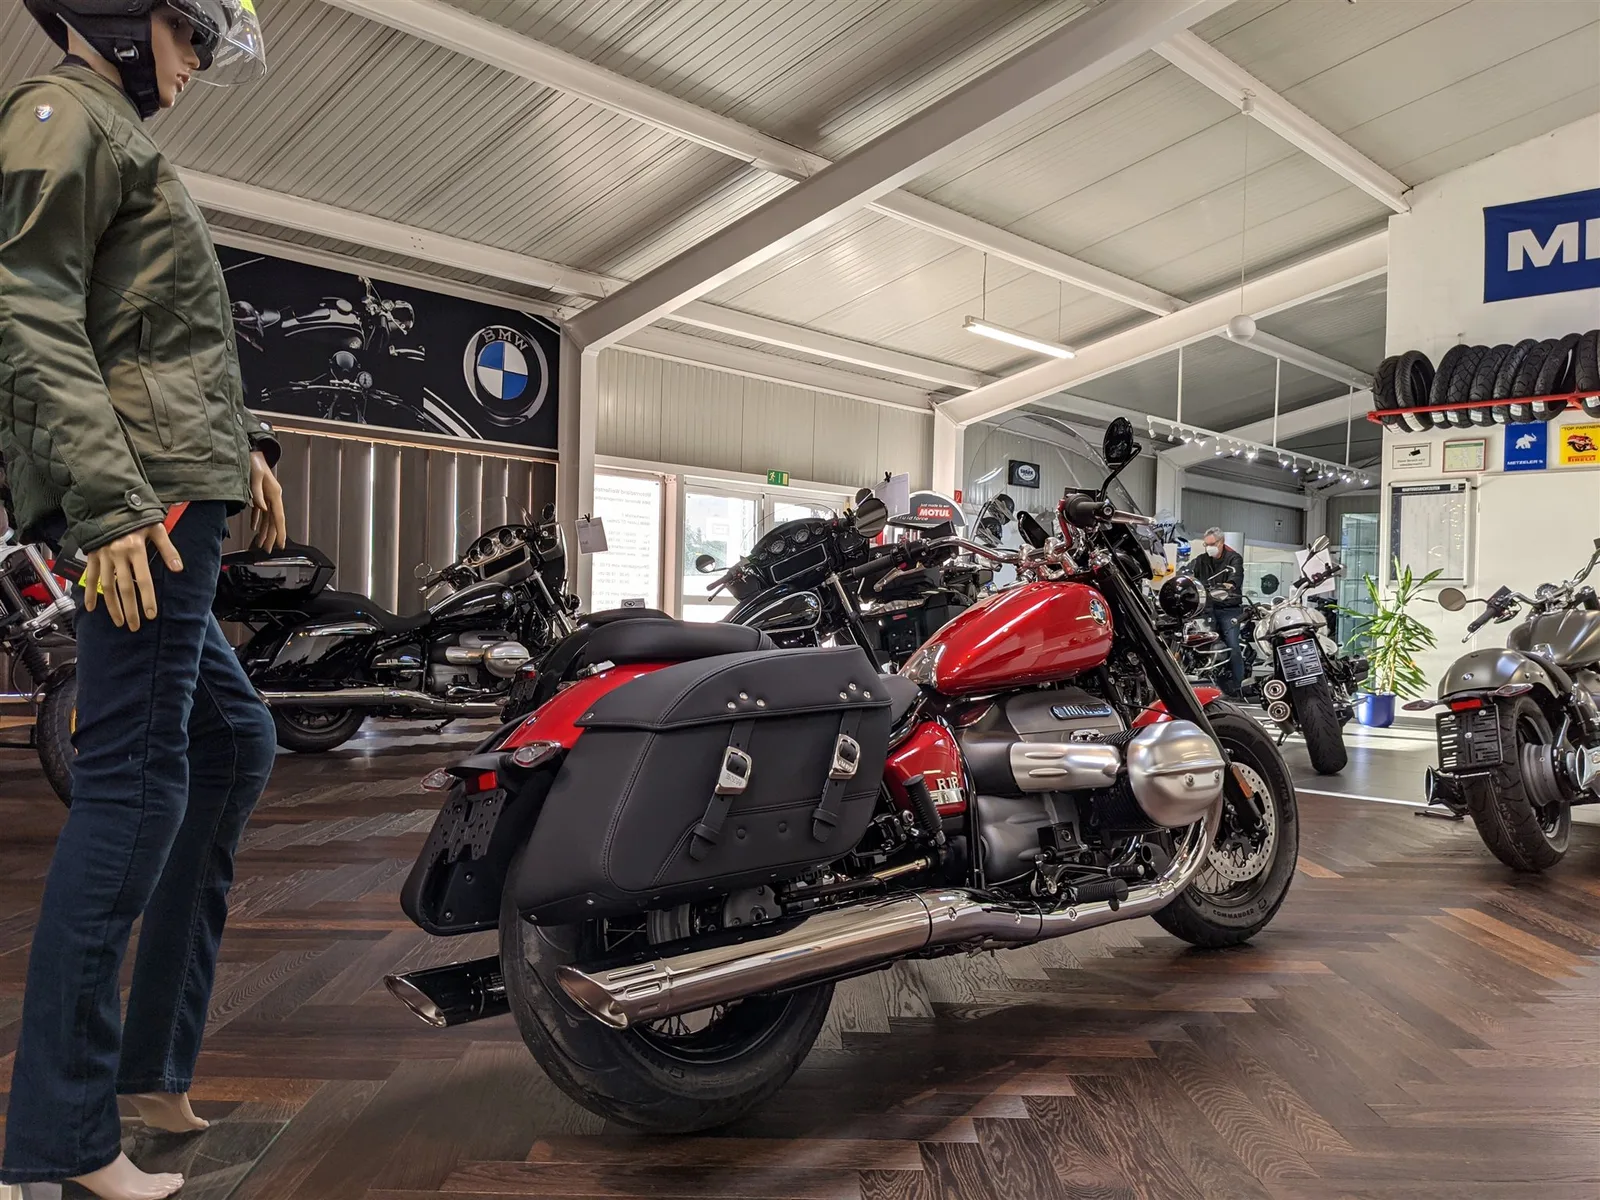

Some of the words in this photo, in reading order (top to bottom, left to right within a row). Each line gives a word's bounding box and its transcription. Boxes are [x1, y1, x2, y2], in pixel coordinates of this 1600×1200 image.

[481, 328, 529, 351] BMW
[919, 508, 950, 517] MOTUL
[1212, 908, 1255, 919] COMMANDER
